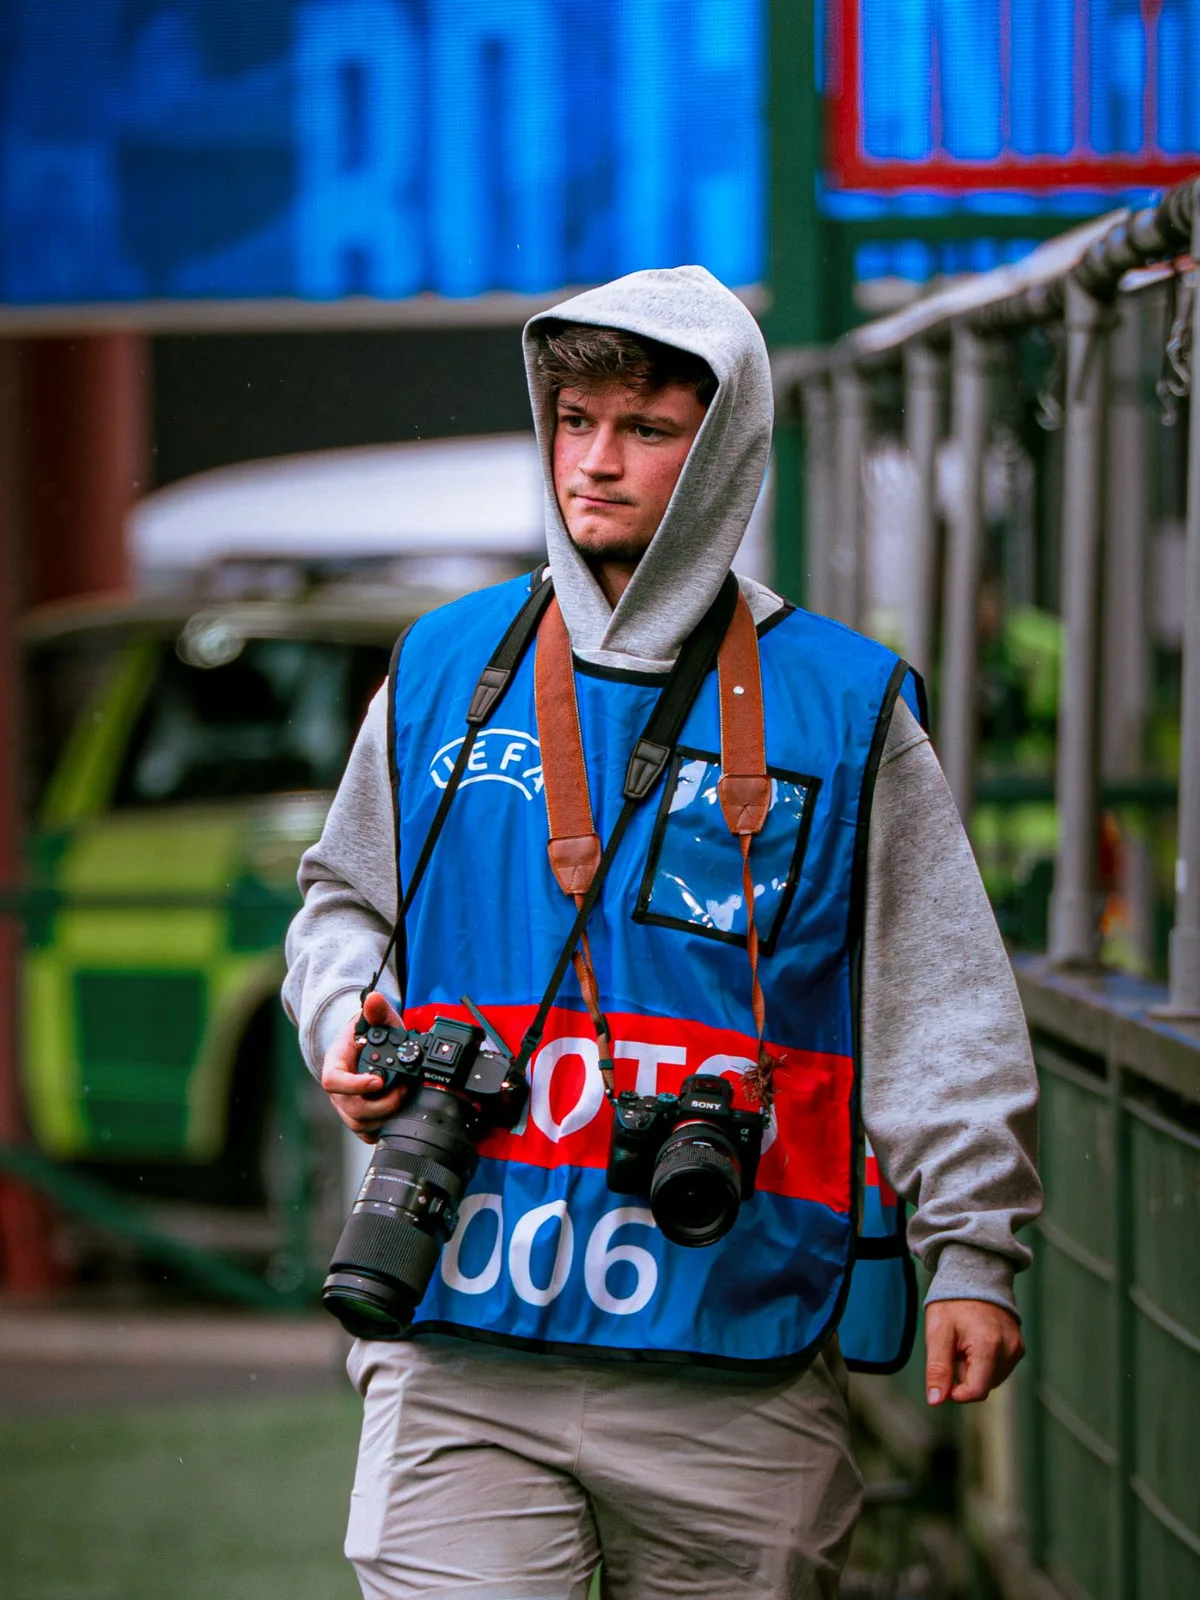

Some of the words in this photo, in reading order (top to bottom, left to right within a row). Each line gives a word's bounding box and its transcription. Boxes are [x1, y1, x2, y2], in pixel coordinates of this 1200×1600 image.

[424, 1072, 451, 1083] SONY
[691, 1100, 722, 1111] SONY
[441, 1193, 658, 1315] 006
